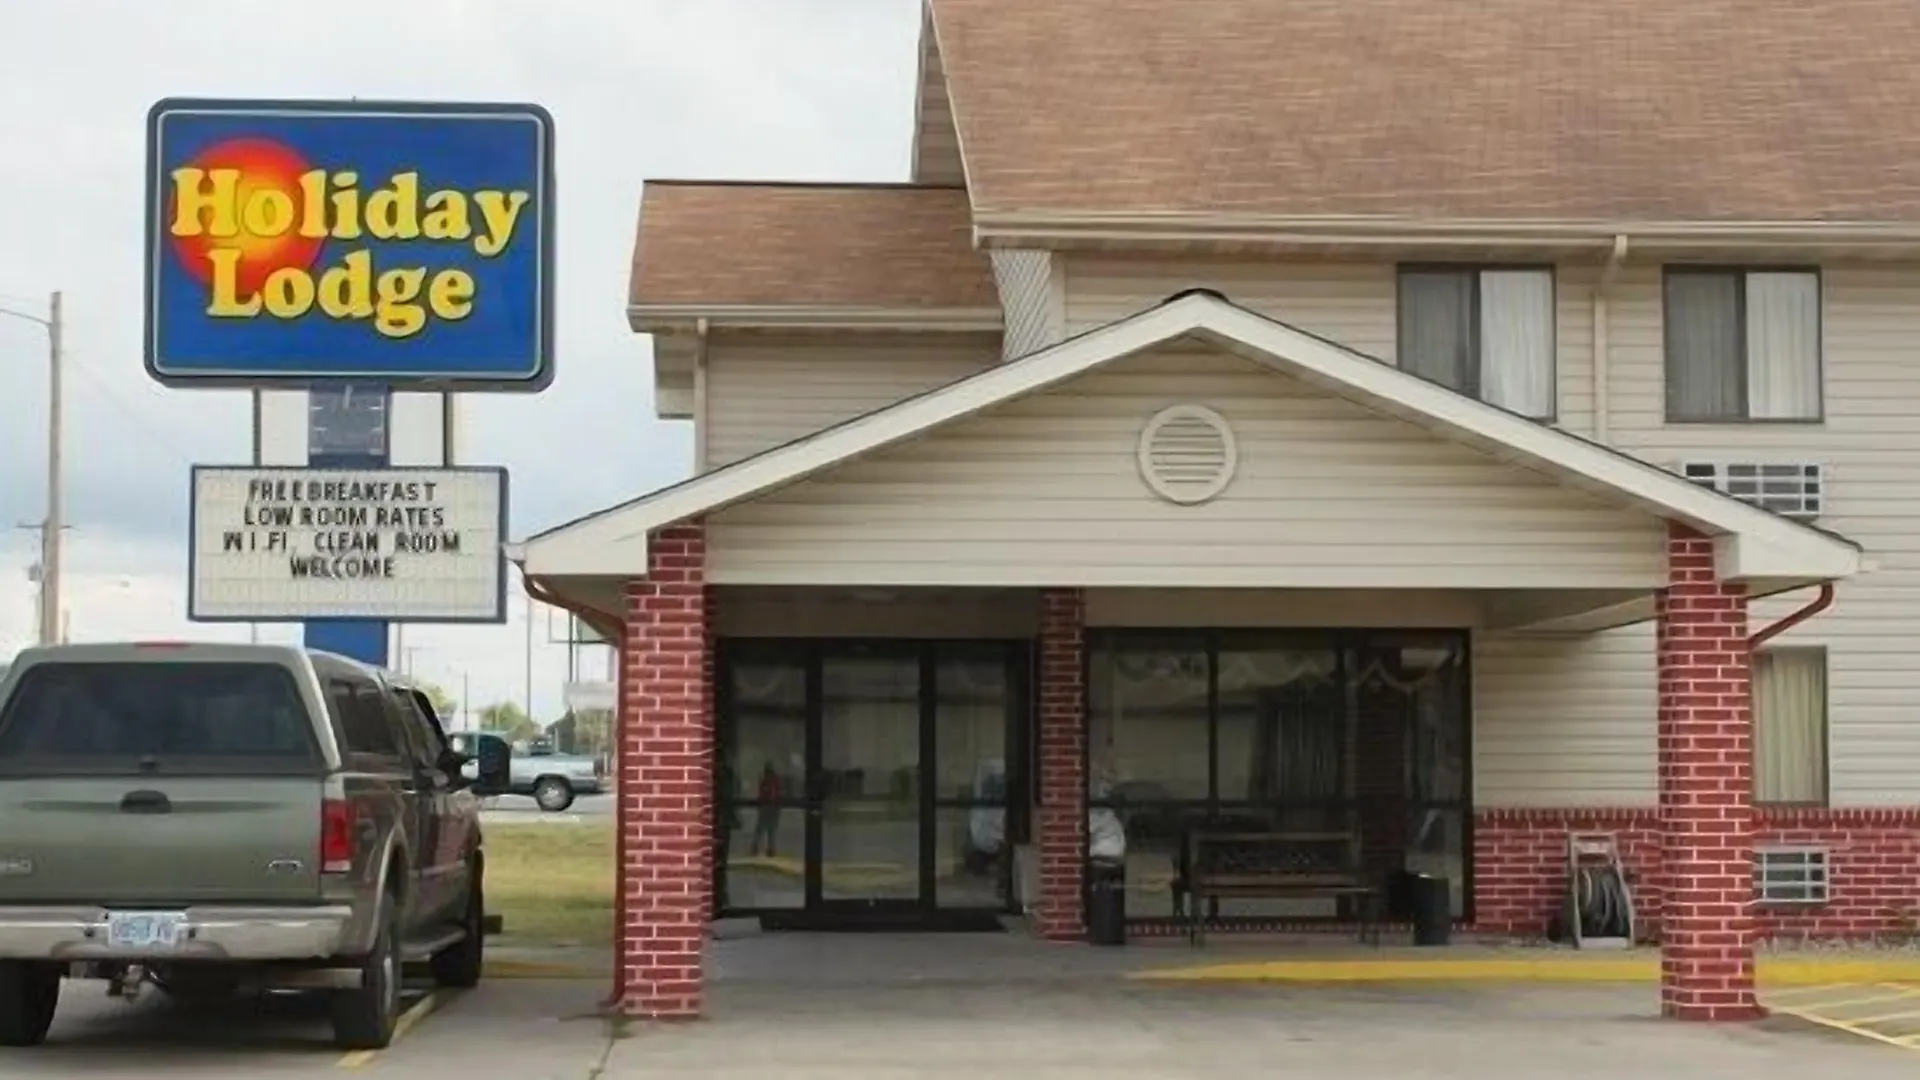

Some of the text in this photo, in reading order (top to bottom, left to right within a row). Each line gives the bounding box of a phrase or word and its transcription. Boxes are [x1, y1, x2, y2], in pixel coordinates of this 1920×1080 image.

[170, 167, 529, 257] Holiday
[206, 248, 476, 338] Lodge
[244, 506, 445, 526] LOW ROOM RATES
[314, 530, 378, 552] CLEAN
[395, 531, 461, 552] ROOM
[289, 555, 395, 579] WELCOME
